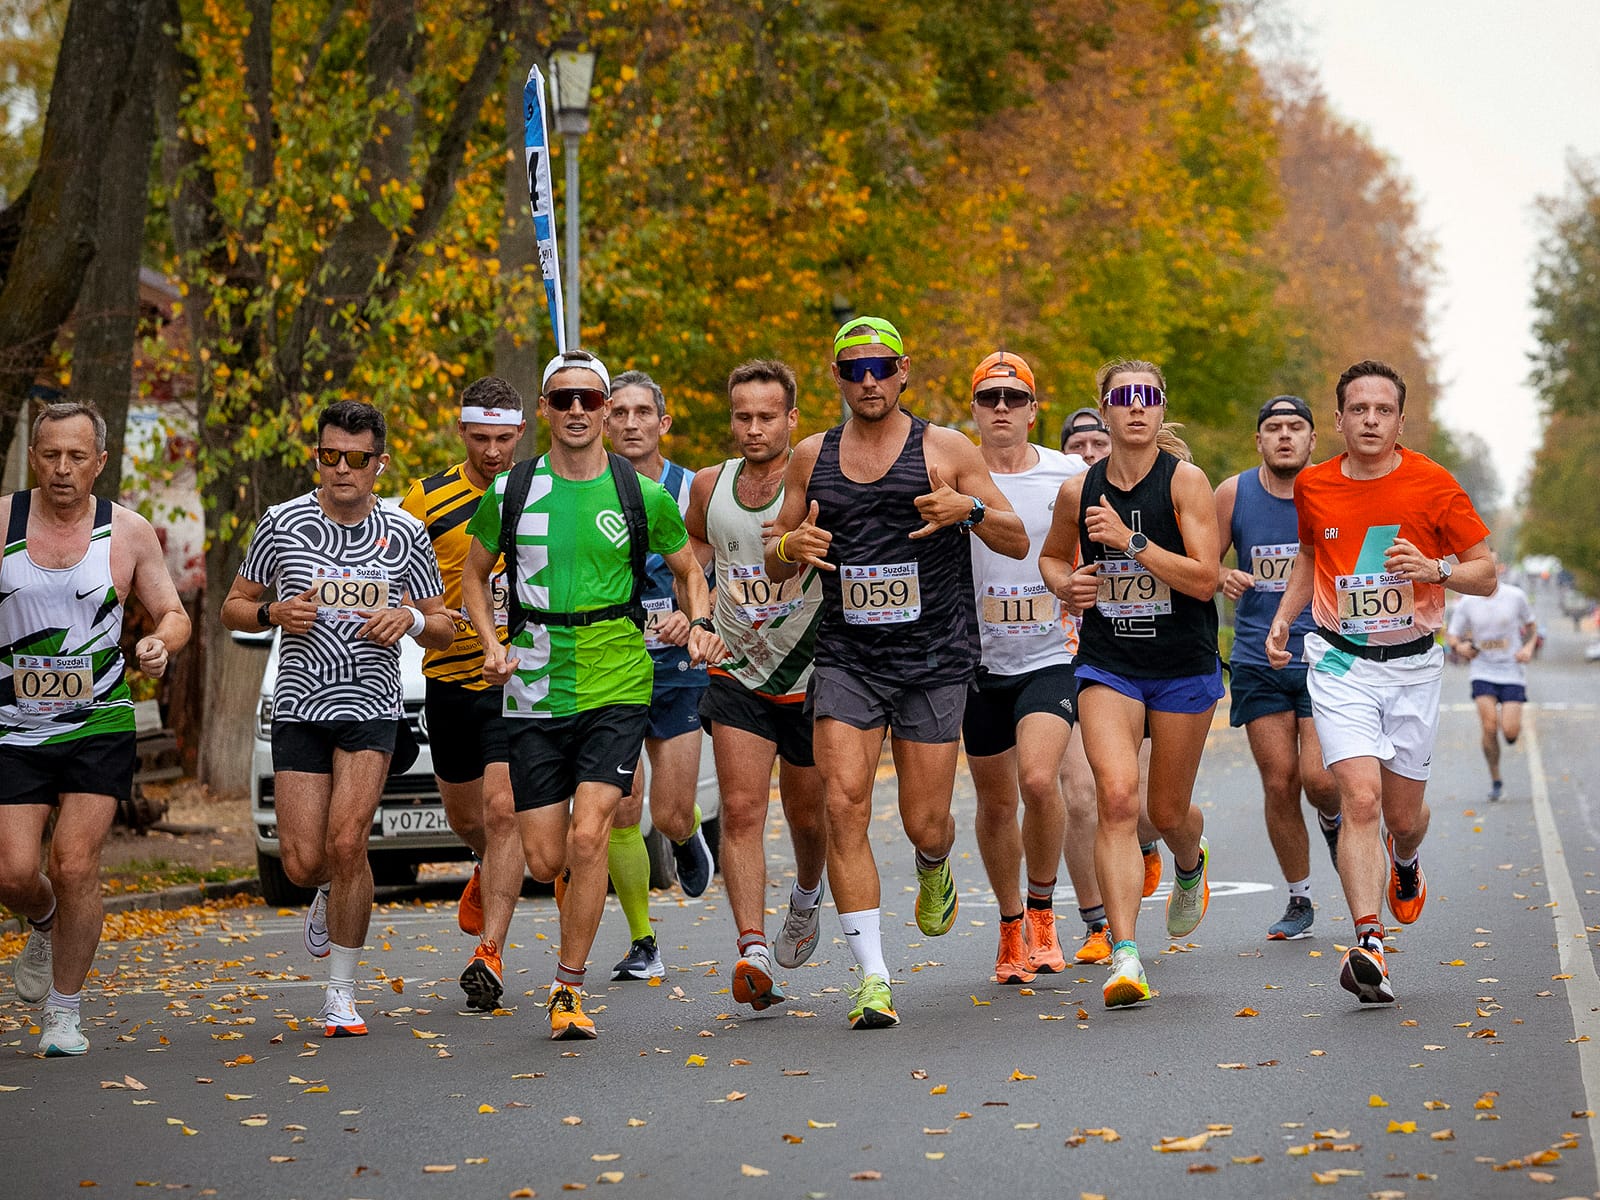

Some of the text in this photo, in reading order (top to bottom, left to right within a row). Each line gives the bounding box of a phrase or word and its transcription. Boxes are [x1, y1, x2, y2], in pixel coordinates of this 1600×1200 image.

[356, 568, 382, 577] Suzdal
[882, 564, 911, 575] Suzdal
[1260, 558, 1295, 580] 07
[320, 581, 379, 608] 080
[740, 579, 786, 605] 107
[850, 580, 909, 608] 059
[1107, 574, 1156, 601] 179
[1000, 598, 1037, 623] 111
[1348, 588, 1403, 618] 150
[56, 657, 84, 667] Suzdal
[22, 671, 83, 698] 020
